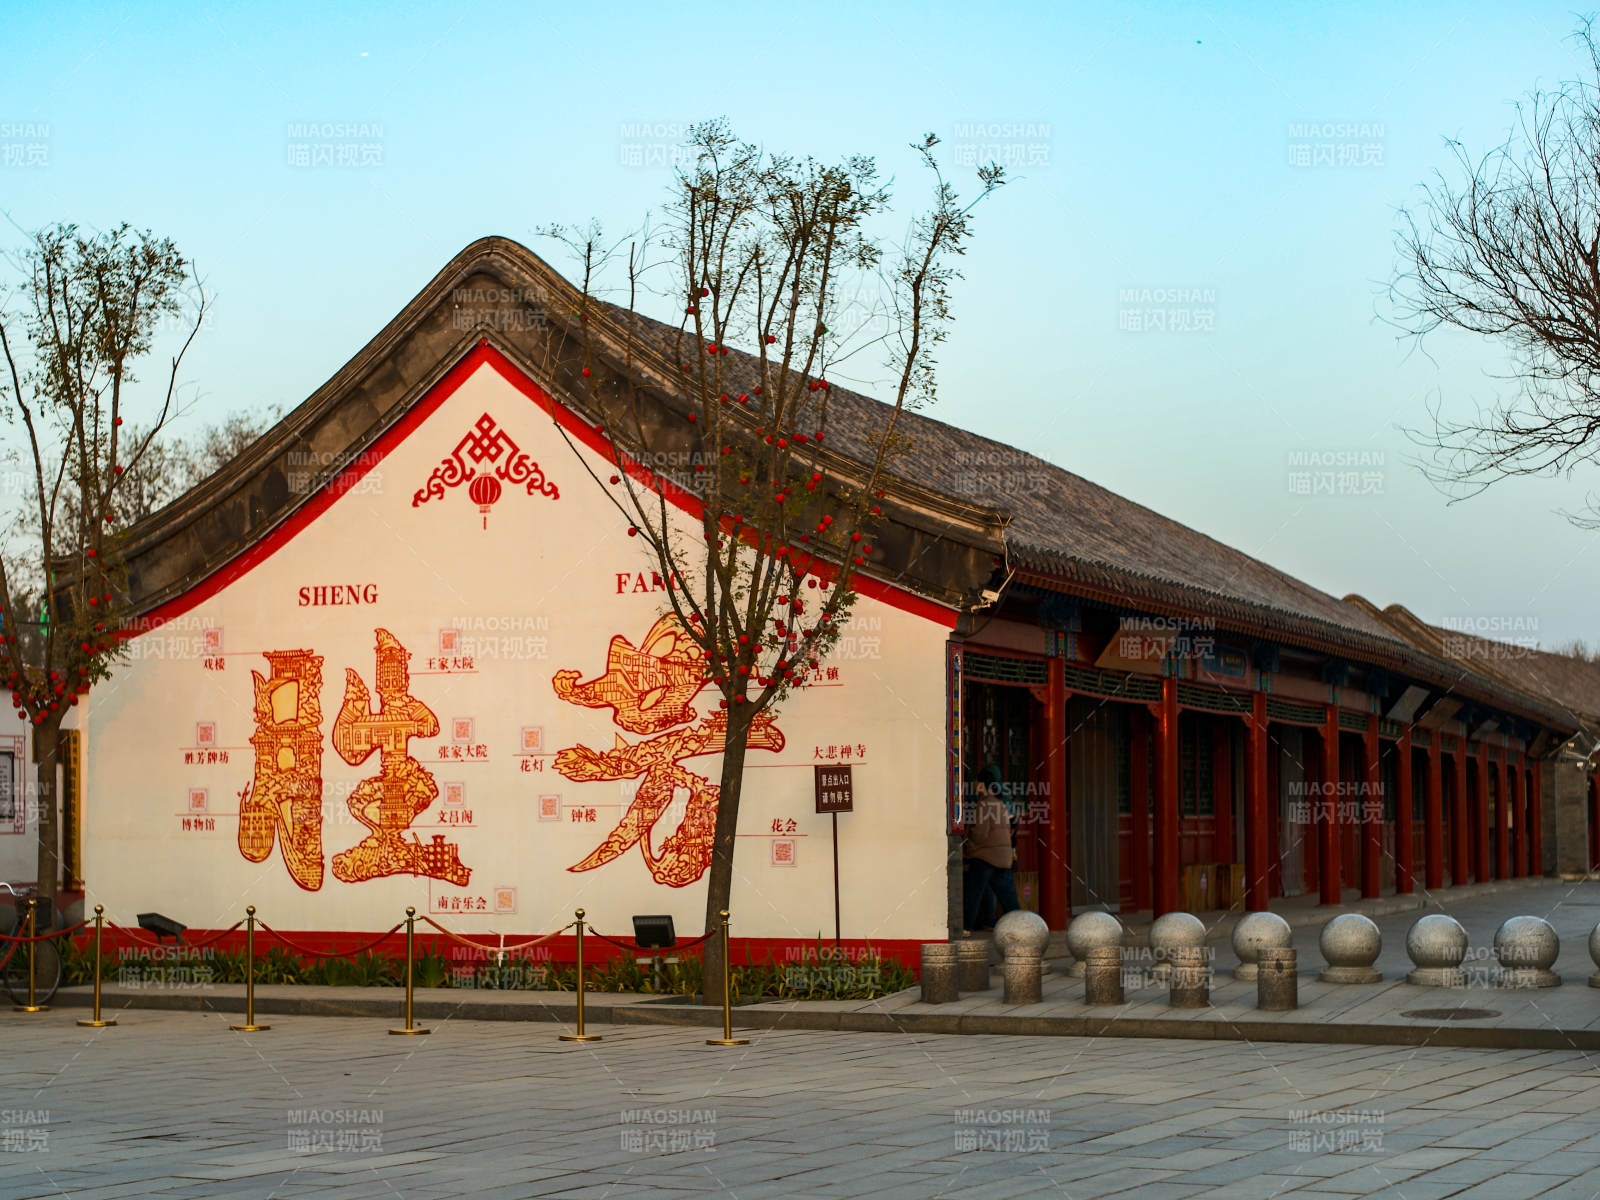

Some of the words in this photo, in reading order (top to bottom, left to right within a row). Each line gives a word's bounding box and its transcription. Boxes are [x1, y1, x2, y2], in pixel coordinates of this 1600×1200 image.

[298, 583, 379, 607] SHENG
[203, 657, 225, 671] 戏楼
[425, 656, 474, 670] 王家大院
[184, 751, 228, 765] 胜芳牌坊
[438, 744, 488, 759] 张家大院
[814, 743, 867, 759] 大悲禅寺
[520, 759, 544, 773] 花灯
[821, 774, 849, 786] 景点出入口
[822, 791, 851, 803] 请勿停车
[437, 809, 473, 824] 文昌阁
[571, 808, 597, 822] 钟楼
[182, 817, 215, 831] 博物馆
[771, 817, 798, 832] 花会
[438, 895, 487, 910] 南音乐会
